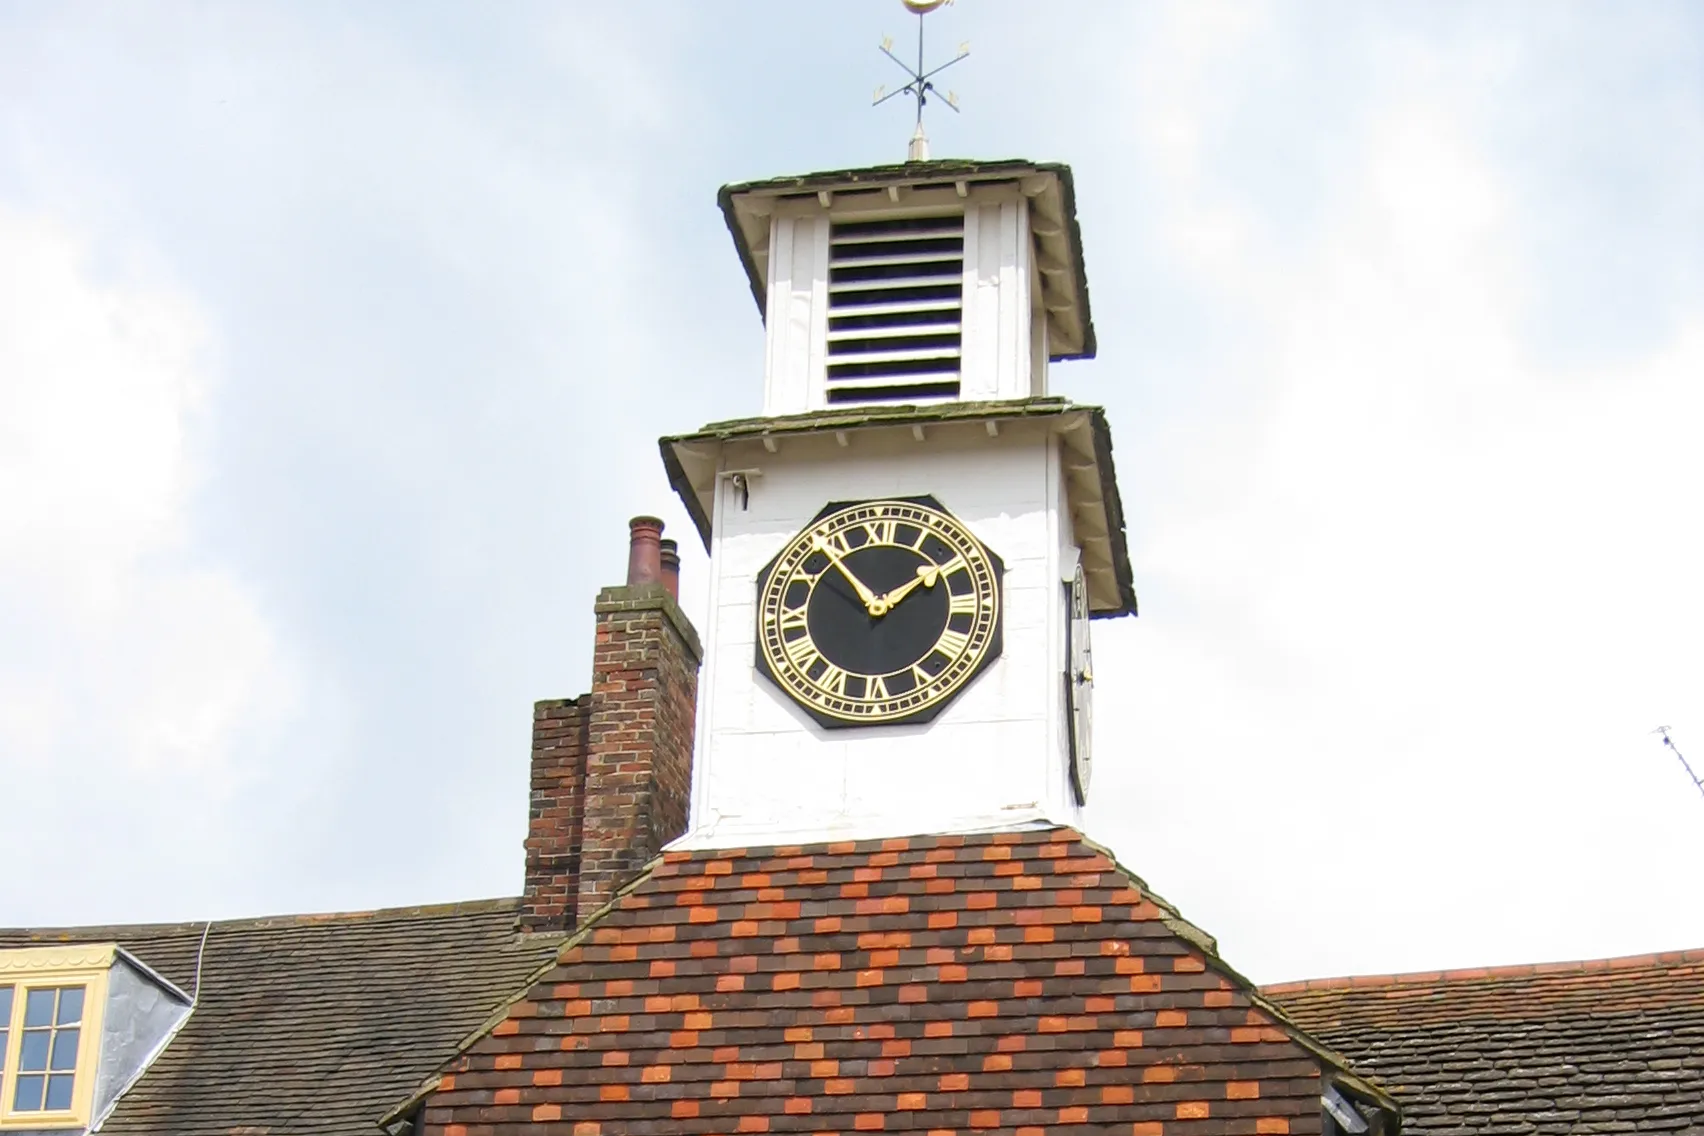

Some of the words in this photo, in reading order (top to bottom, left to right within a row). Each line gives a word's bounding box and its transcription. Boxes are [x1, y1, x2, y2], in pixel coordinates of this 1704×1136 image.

[864, 521, 898, 546] XII
[791, 566, 818, 589] X
[939, 552, 968, 578] II
[949, 593, 977, 615] III
[781, 606, 806, 632] IX
[934, 629, 968, 659] IIII
[786, 640, 817, 675] VIII
[816, 667, 847, 696] VII
[865, 675, 891, 701] VI
[912, 664, 935, 688] V
